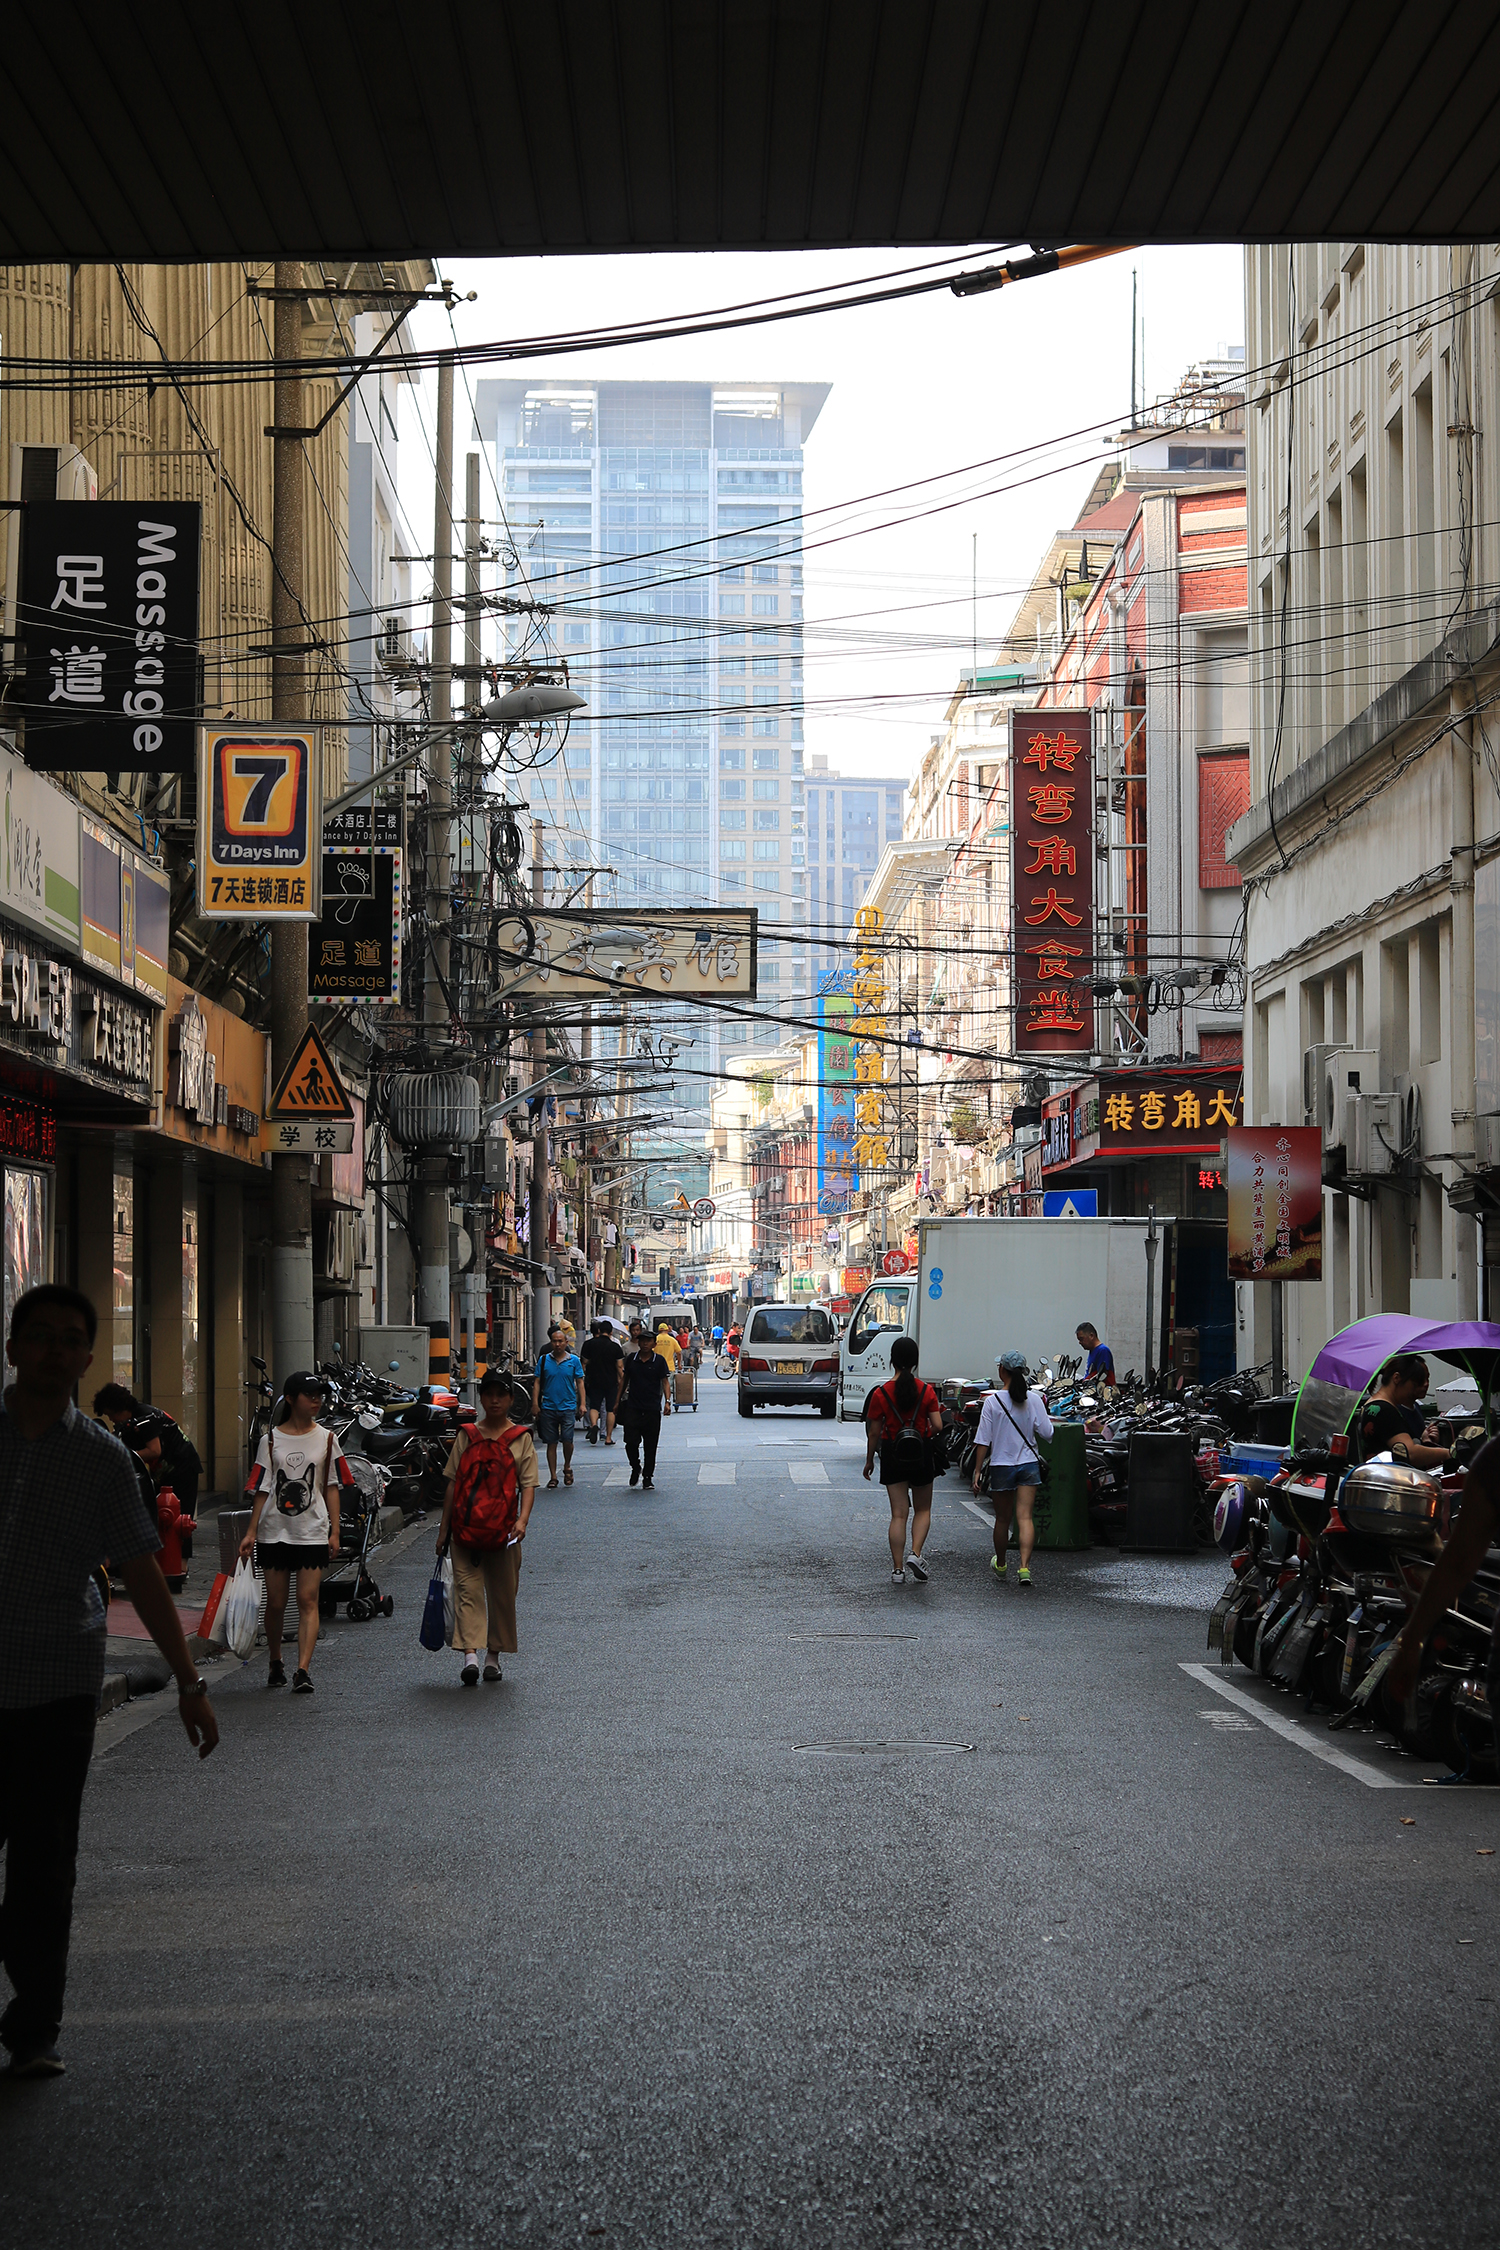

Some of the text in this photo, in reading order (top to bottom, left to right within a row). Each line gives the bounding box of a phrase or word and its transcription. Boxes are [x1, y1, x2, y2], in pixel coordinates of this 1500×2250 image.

[48, 554, 108, 703] 足道
[123, 520, 177, 753] Massage
[231, 755, 290, 825] 7
[323, 813, 397, 829] 7天酒店上二楼
[344, 832, 353, 842] by
[356, 832, 361, 840] 7
[363, 832, 382, 842] Days
[385, 832, 398, 840] Inn
[274, 845, 299, 859] Inn
[211, 877, 306, 905] 7天连锁酒店
[1022, 731, 1085, 1031] 转弯角大食堂
[320, 938, 382, 967] 足道
[313, 973, 386, 991] Massage
[1103, 1089, 1244, 1132] 转弯角大
[280, 1126, 337, 1149] 学校
[698, 1203, 712, 1215] 30
[1251, 1150, 1266, 1273] 合力共筑美丽黄浦梦
[1275, 1136, 1292, 1259] 齐心同创全国文明城
[888, 1254, 906, 1273] 停
